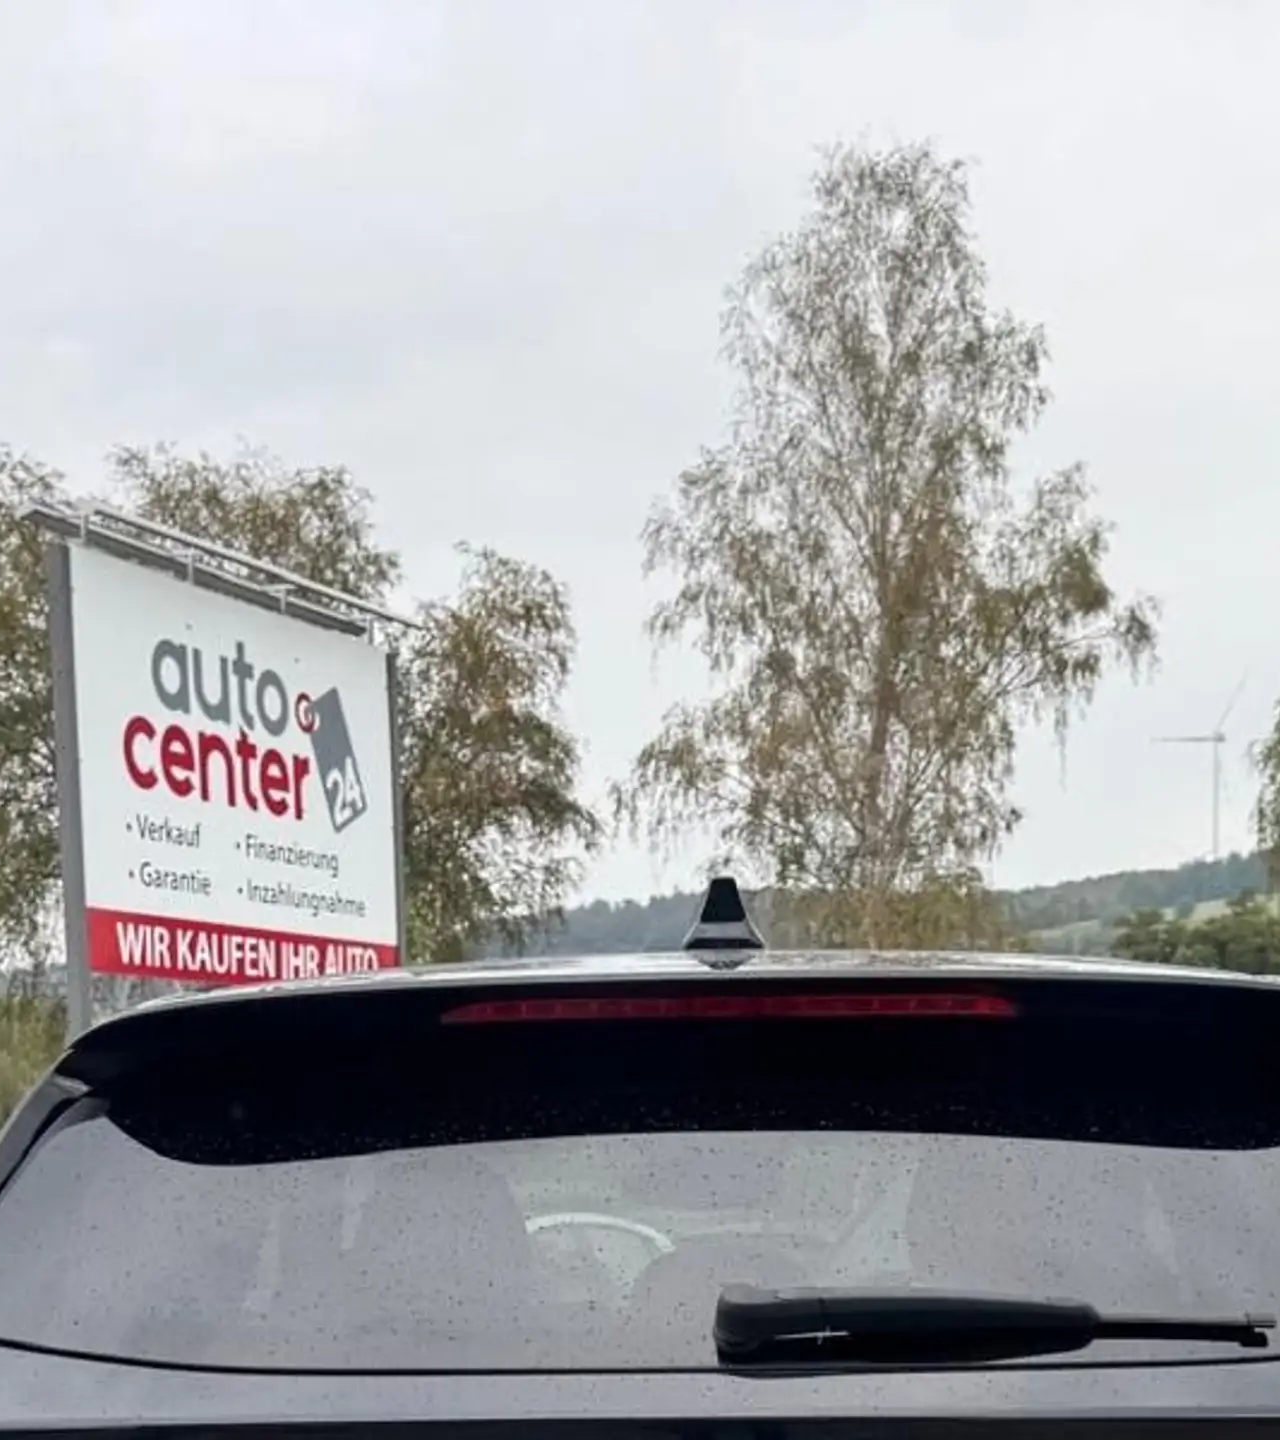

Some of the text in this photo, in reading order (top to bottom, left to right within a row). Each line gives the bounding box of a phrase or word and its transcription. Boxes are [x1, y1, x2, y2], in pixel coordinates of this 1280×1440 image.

[151, 639, 289, 736] auto
[123, 716, 311, 820] center
[325, 756, 363, 823] 24
[136, 814, 201, 847] Verkauf
[245, 834, 339, 877] Finanzierung
[139, 861, 212, 895] Garantie
[247, 878, 366, 918] Inzahlungnahme
[116, 922, 170, 969] WIR
[176, 929, 275, 978] KAUFEN
[280, 942, 320, 981] IHR
